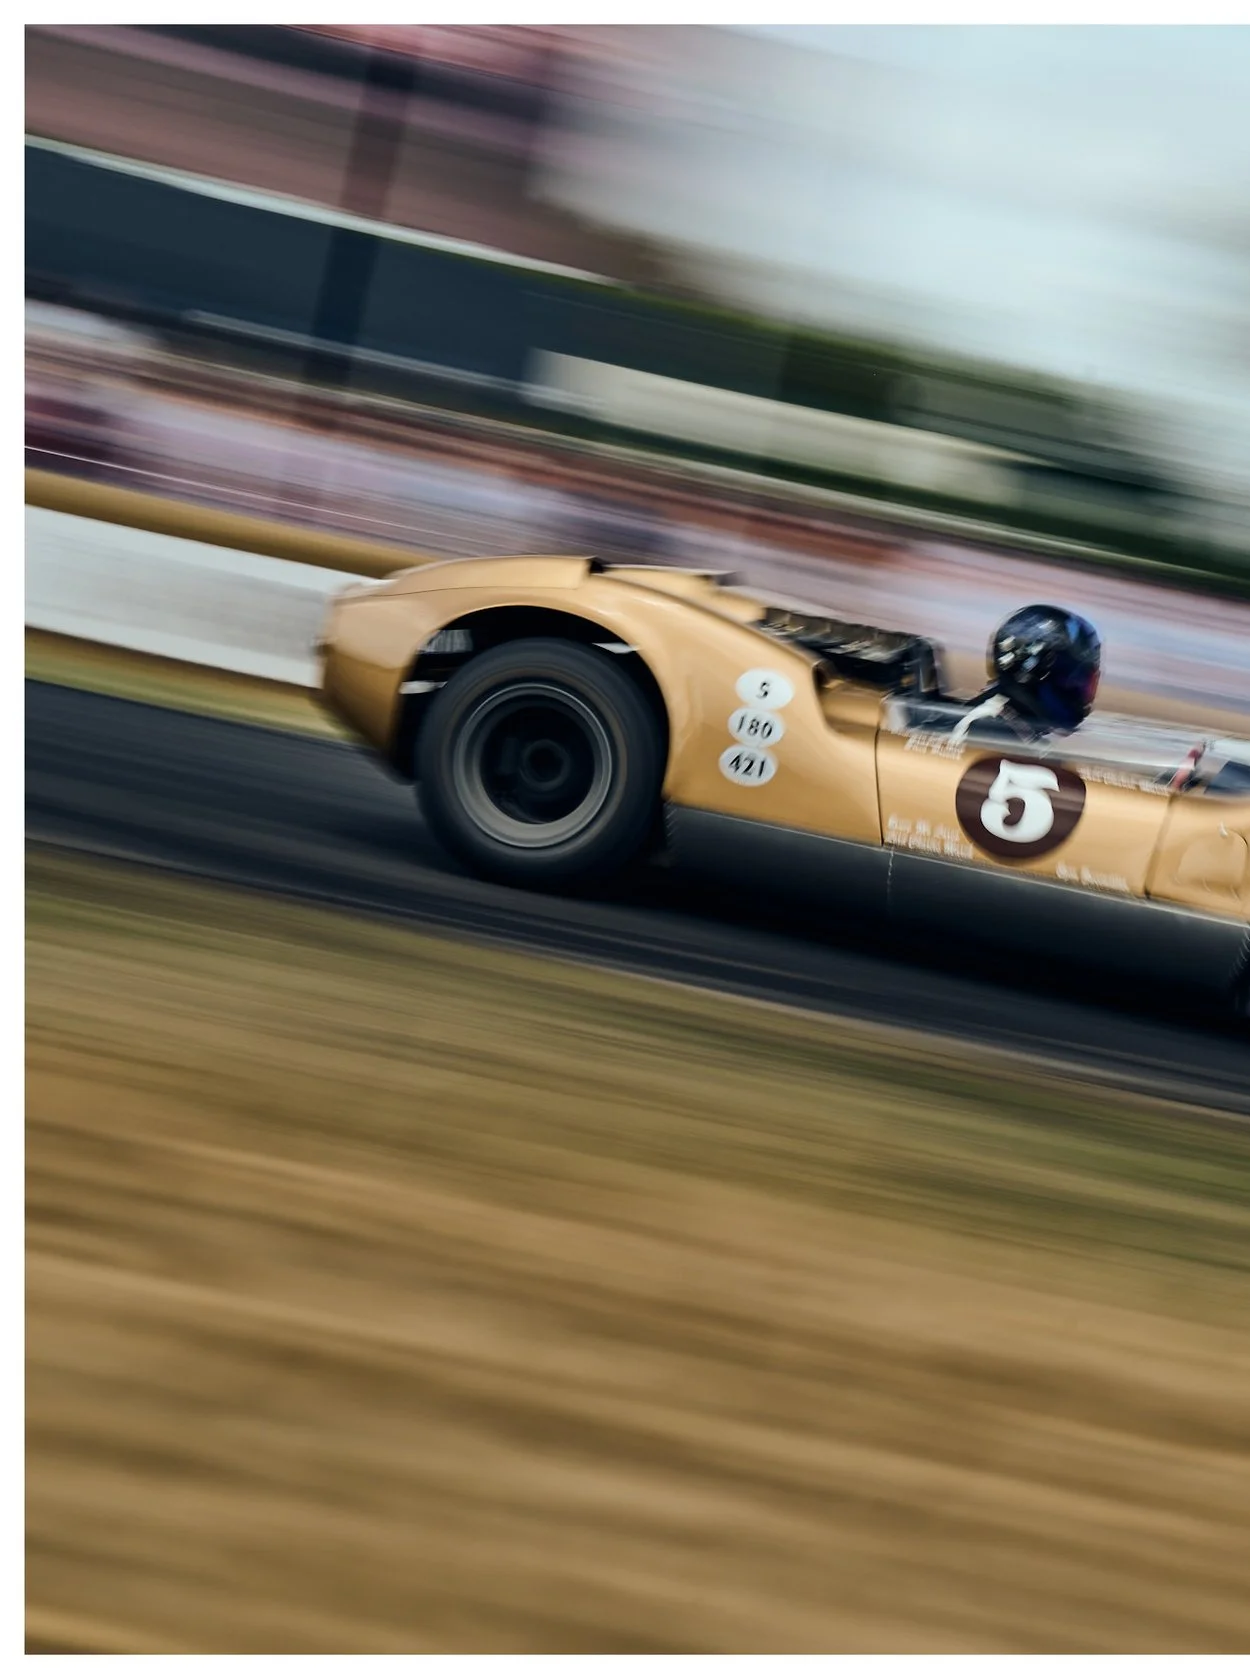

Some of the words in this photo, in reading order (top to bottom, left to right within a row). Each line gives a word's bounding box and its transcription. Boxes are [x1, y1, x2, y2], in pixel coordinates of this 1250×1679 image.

[737, 713, 774, 739] 180
[729, 751, 767, 778] 421
[980, 759, 1060, 843] 5
